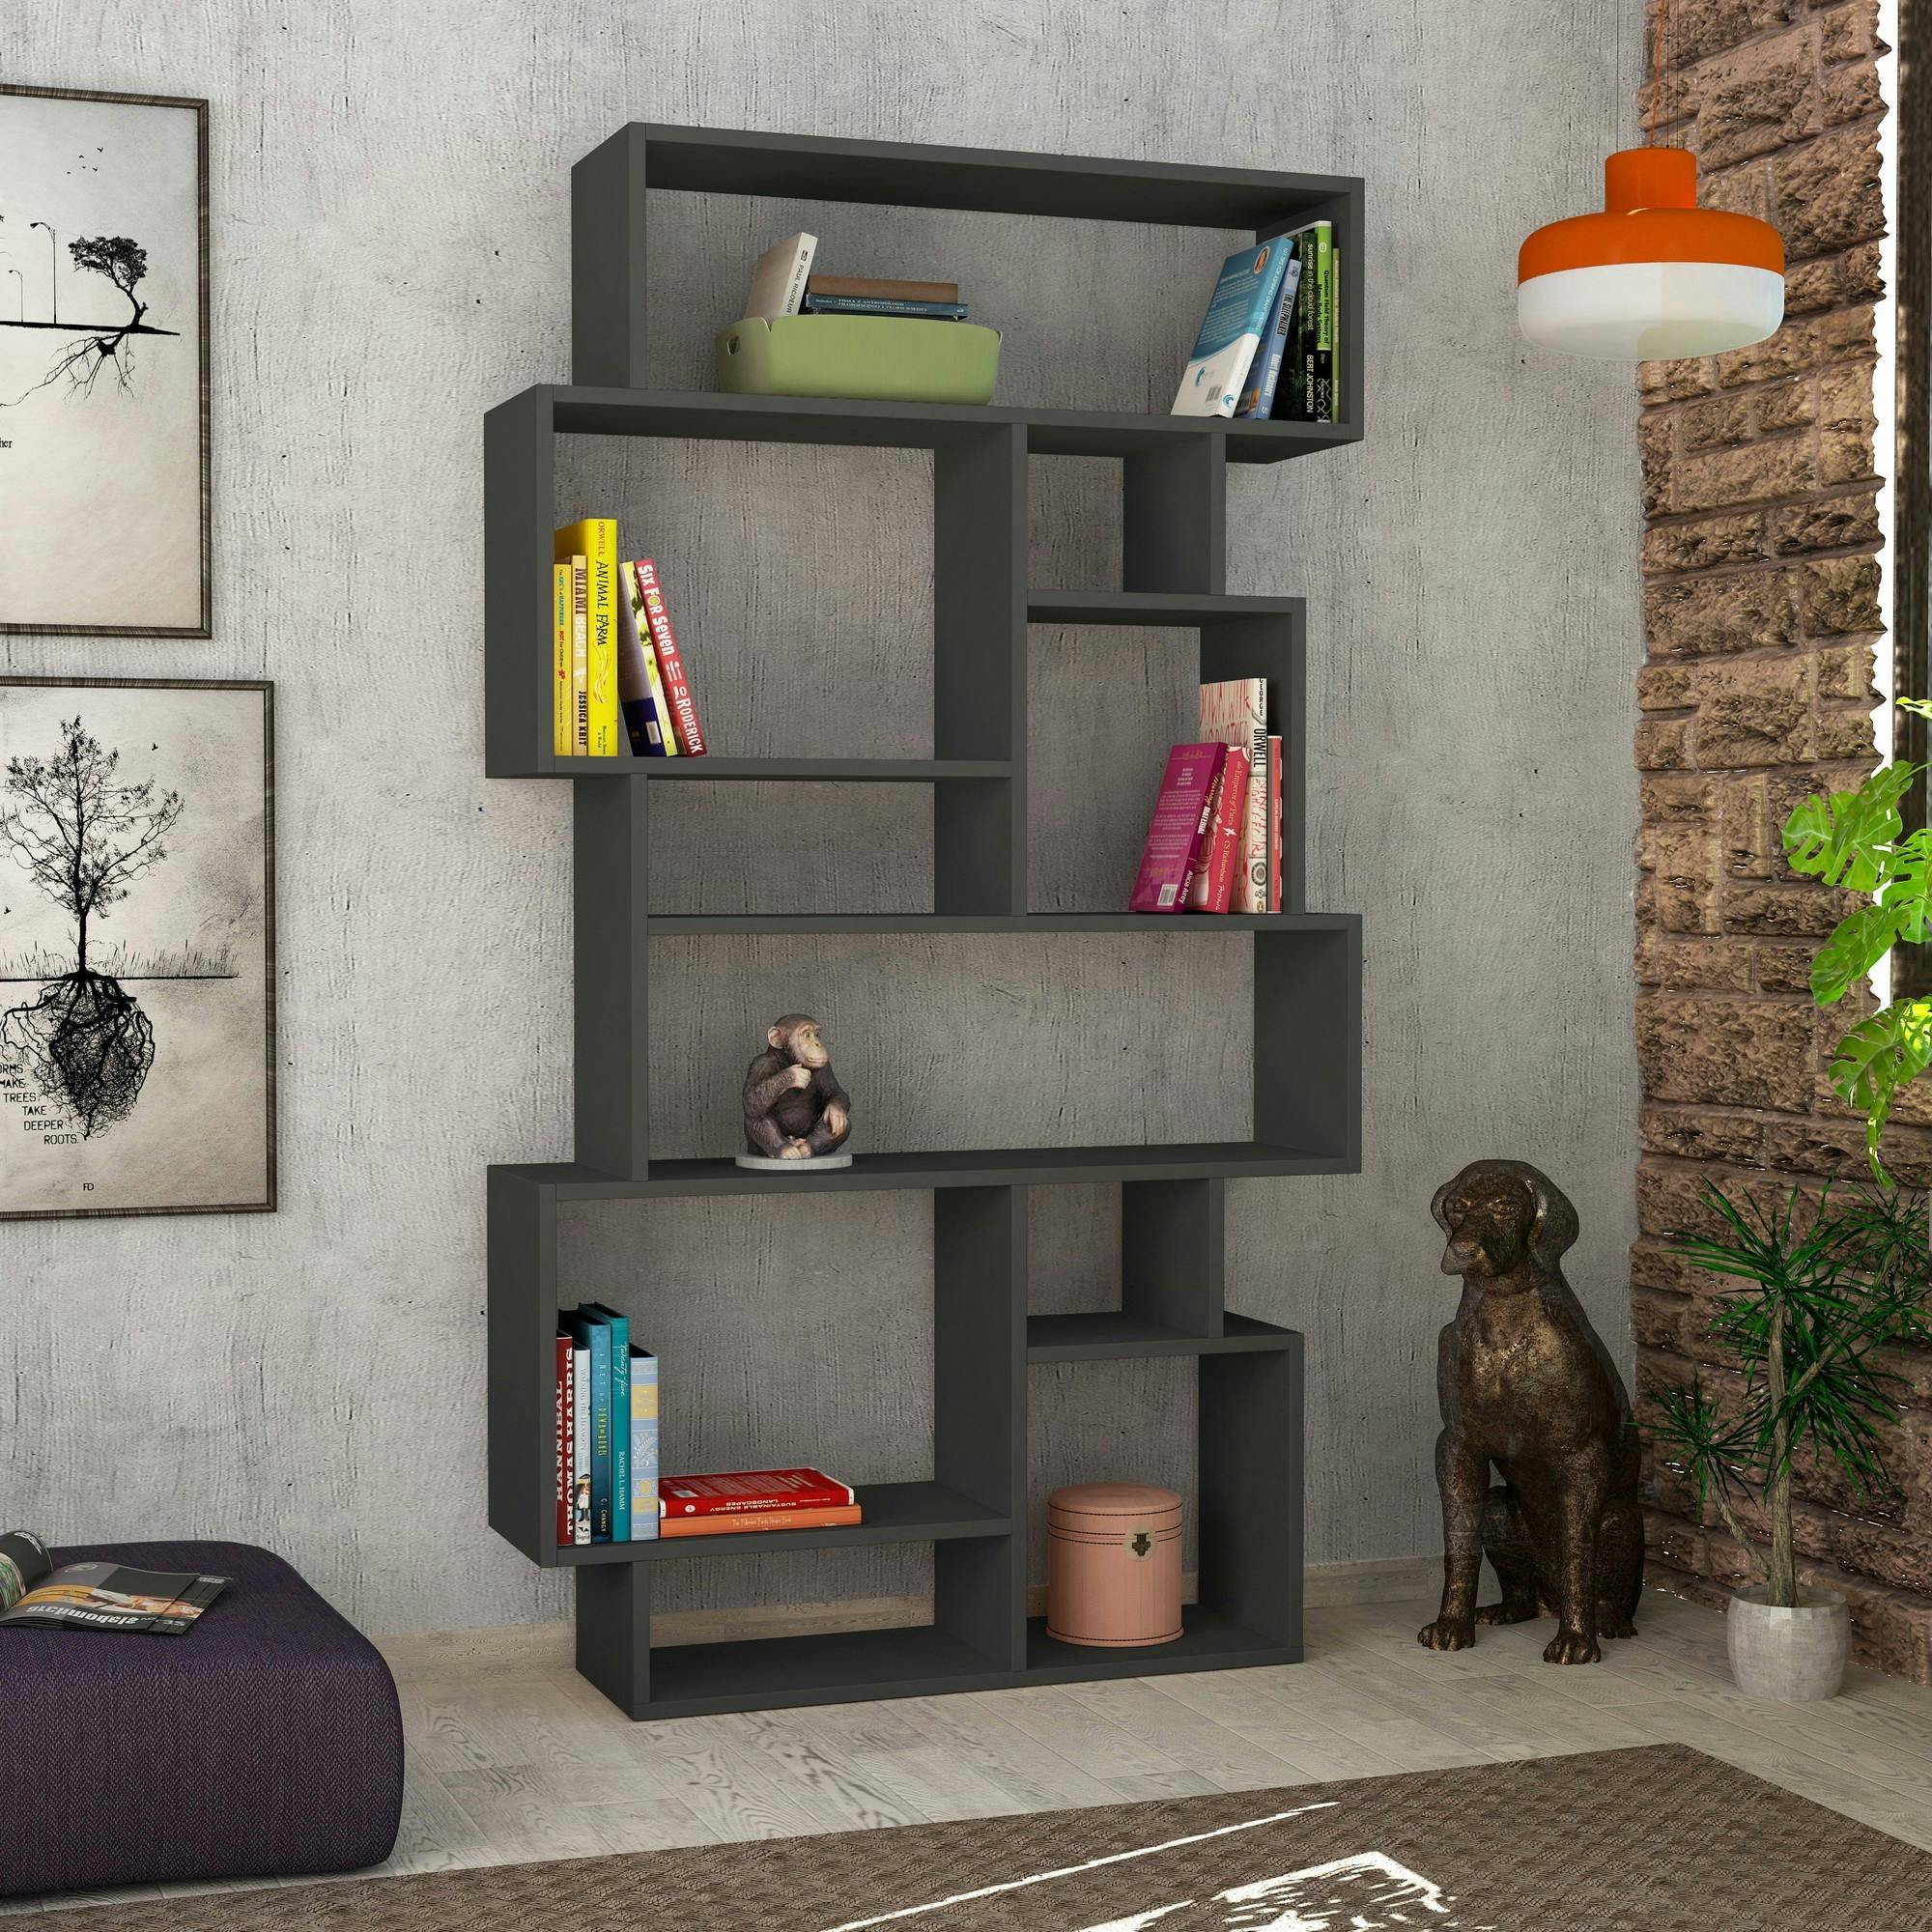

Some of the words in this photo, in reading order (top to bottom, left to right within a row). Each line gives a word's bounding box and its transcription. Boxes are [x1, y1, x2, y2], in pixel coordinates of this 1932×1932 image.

[795, 264, 805, 284] PAUL
[786, 283, 799, 314] RICOEUR
[1276, 302, 1293, 336] SLEEPWALKER
[1323, 336, 1330, 345] of
[595, 560, 610, 610] ANIMAL
[638, 564, 656, 586] SIX
[575, 568, 586, 614] MIAMI
[644, 587, 663, 615] FOR
[575, 615, 586, 657] BEACH
[595, 613, 610, 646] FARM
[673, 685, 687, 700] JO
[675, 697, 704, 754] RODERICK
[1253, 728, 1266, 768] ORWELL
[1232, 770, 1242, 800] Emperor
[1198, 806, 1211, 835] MATERIAL
[1228, 807, 1236, 826] Paris
[1184, 870, 1194, 888] Alicia
[1219, 850, 1230, 882] Richardson
[1179, 887, 1188, 904] Airey
[3, 1093, 37, 1102] TREES
[22, 1106, 47, 1116] TAKE
[24, 1120, 64, 1131] DEEPER
[744, 1501, 797, 1510] SUSTAINABLE
